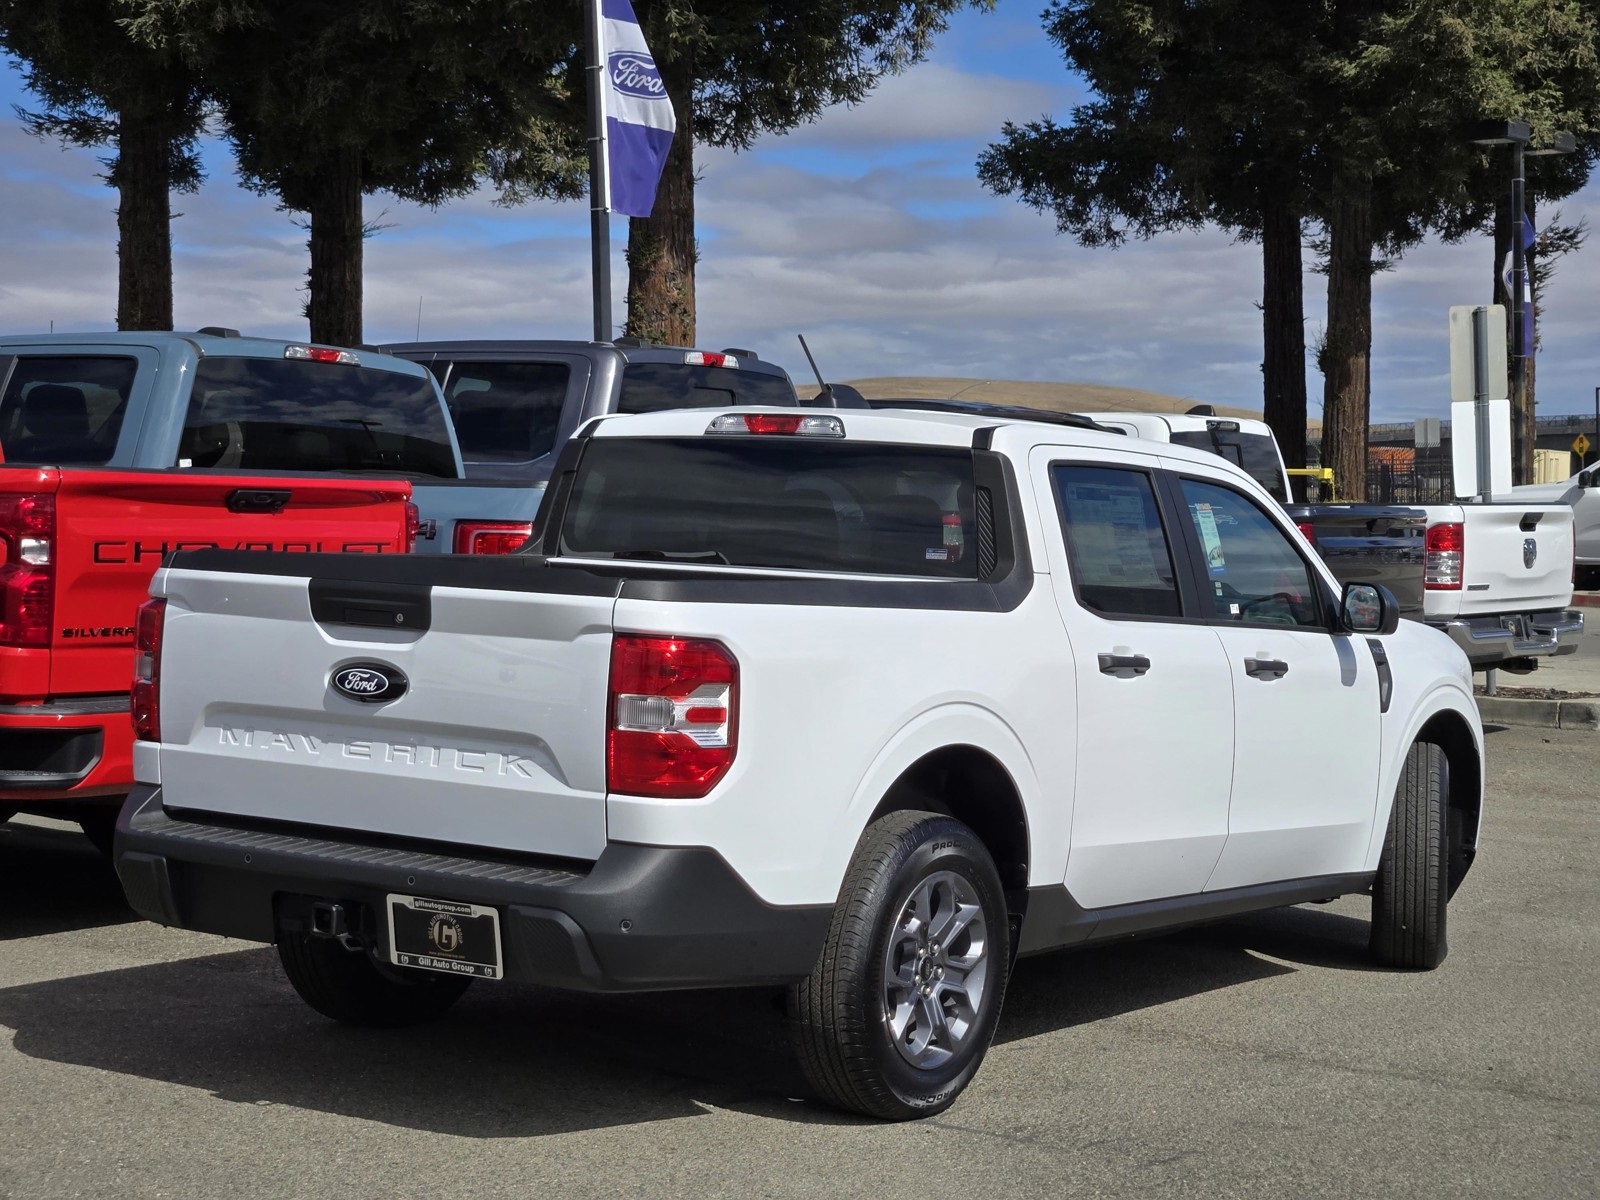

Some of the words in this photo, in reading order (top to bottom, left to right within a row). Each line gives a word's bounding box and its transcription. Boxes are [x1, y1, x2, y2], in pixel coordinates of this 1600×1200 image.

[613, 57, 664, 93] Ford
[62, 628, 135, 638] SILVERA
[344, 671, 378, 691] Ford
[218, 723, 534, 779] MAVERICK
[414, 900, 471, 913] gillautogroup.com
[418, 957, 431, 966] Gill
[433, 959, 450, 969] Auto
[452, 961, 475, 974] Group
